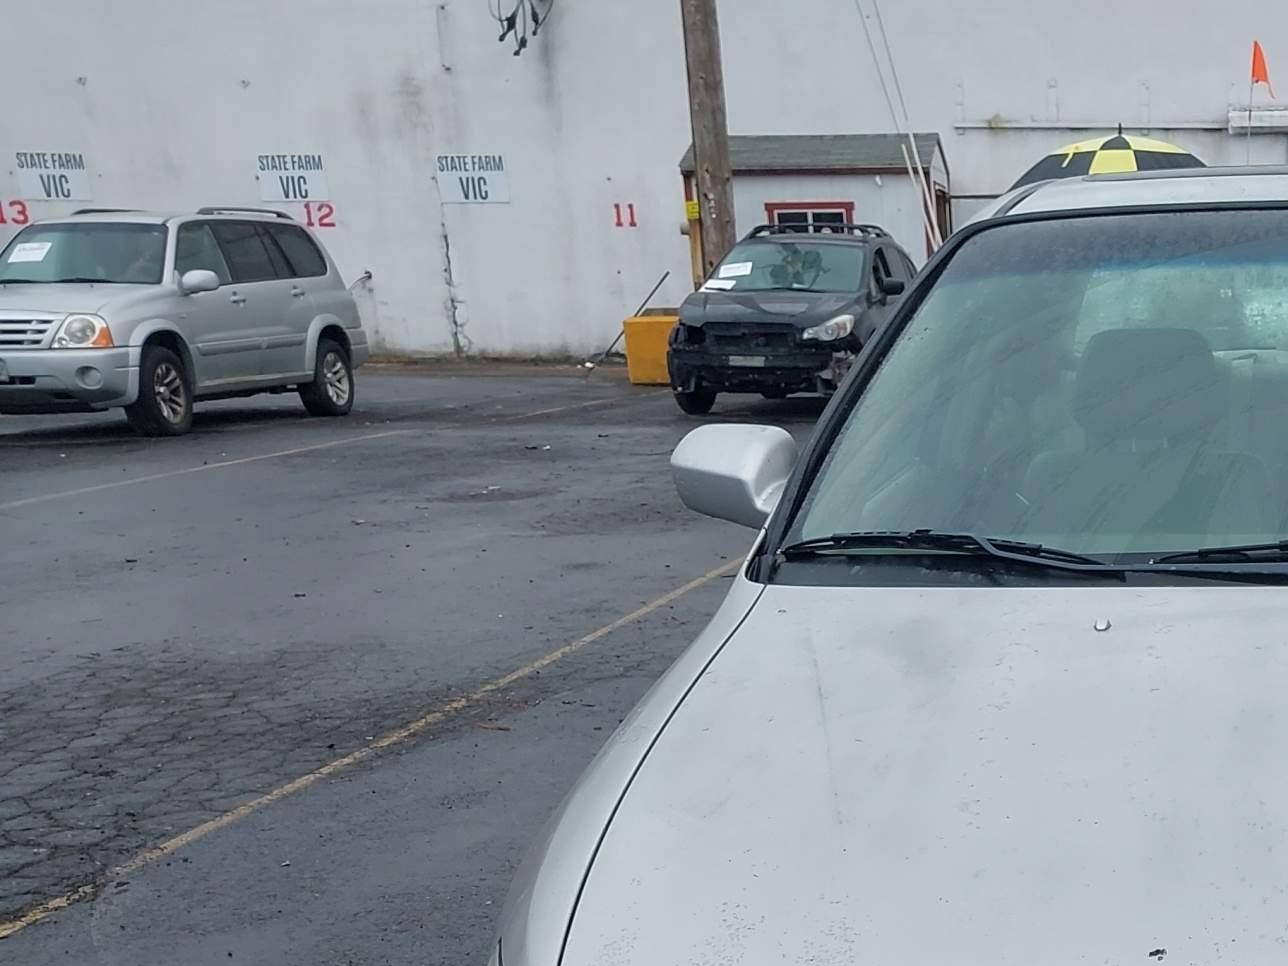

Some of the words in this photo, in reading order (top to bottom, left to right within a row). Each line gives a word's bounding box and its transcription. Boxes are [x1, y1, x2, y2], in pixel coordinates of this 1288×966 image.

[16, 152, 50, 169] STATE
[51, 152, 85, 170] FARM
[258, 154, 289, 171] STATE
[290, 154, 323, 171] FARM
[437, 155, 470, 172] STATE
[471, 155, 504, 172] FARM
[39, 174, 71, 198] VIC
[279, 175, 308, 199] VIC
[459, 176, 488, 200] VIC
[303, 202, 336, 227] 12
[613, 203, 637, 227] 11
